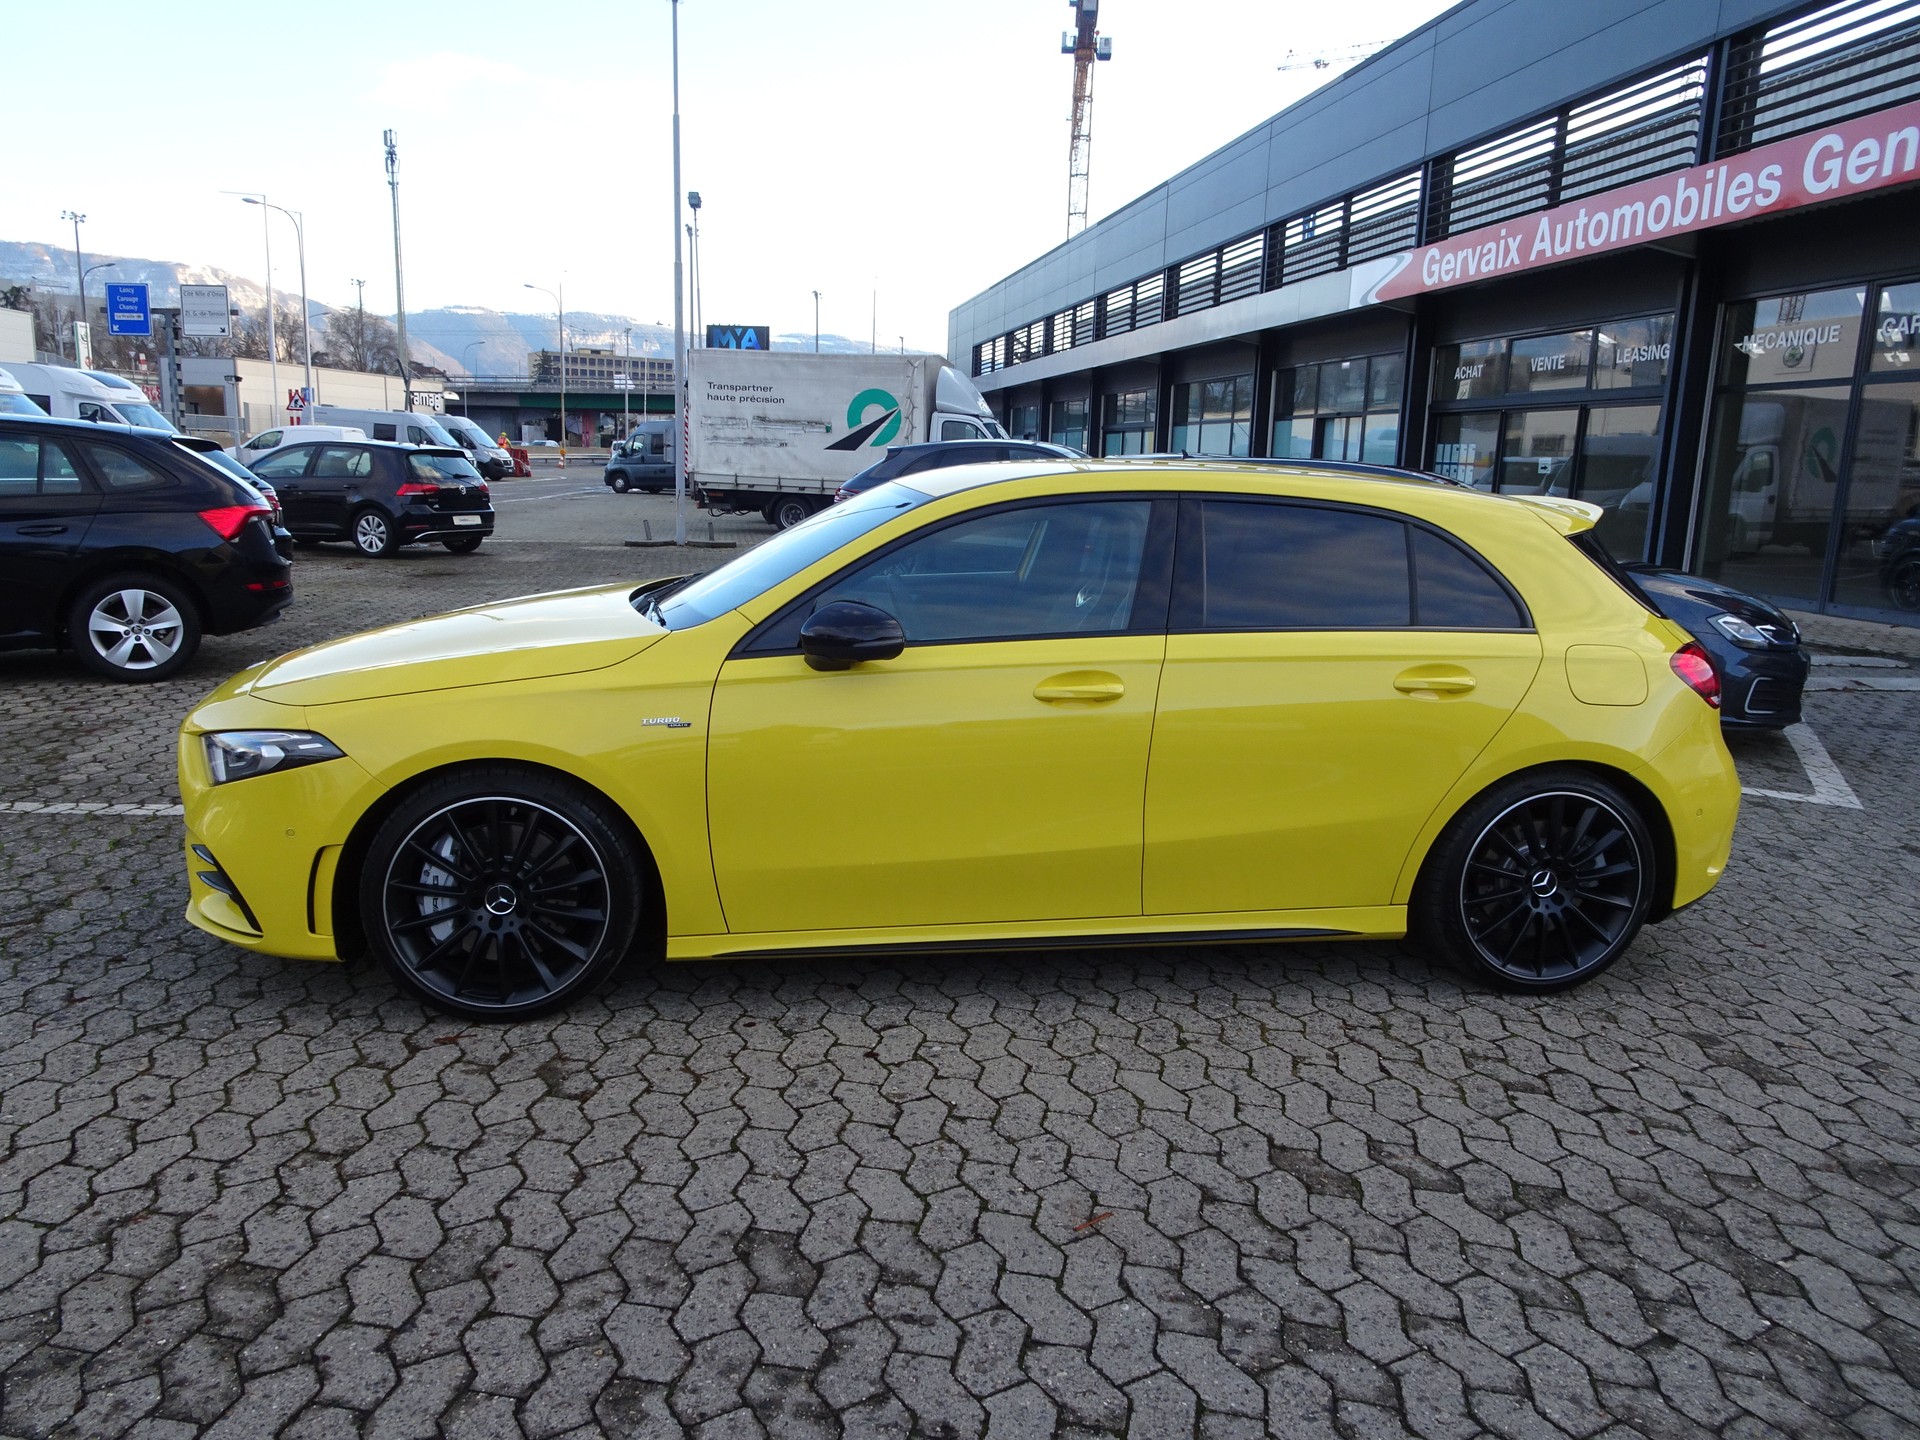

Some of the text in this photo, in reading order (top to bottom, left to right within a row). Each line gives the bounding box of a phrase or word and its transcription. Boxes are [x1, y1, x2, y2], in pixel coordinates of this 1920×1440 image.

[1422, 125, 1920, 287] Gervaix Automobiles Gen
[116, 295, 139, 303] Carouge
[1742, 324, 1842, 350] MECANIQUE
[1454, 343, 1671, 380] ACHAT VENTE LEASING
[707, 381, 774, 393] Transpartner
[411, 391, 441, 411] amag
[706, 393, 785, 404] haute précision
[641, 716, 680, 724] TURBO
